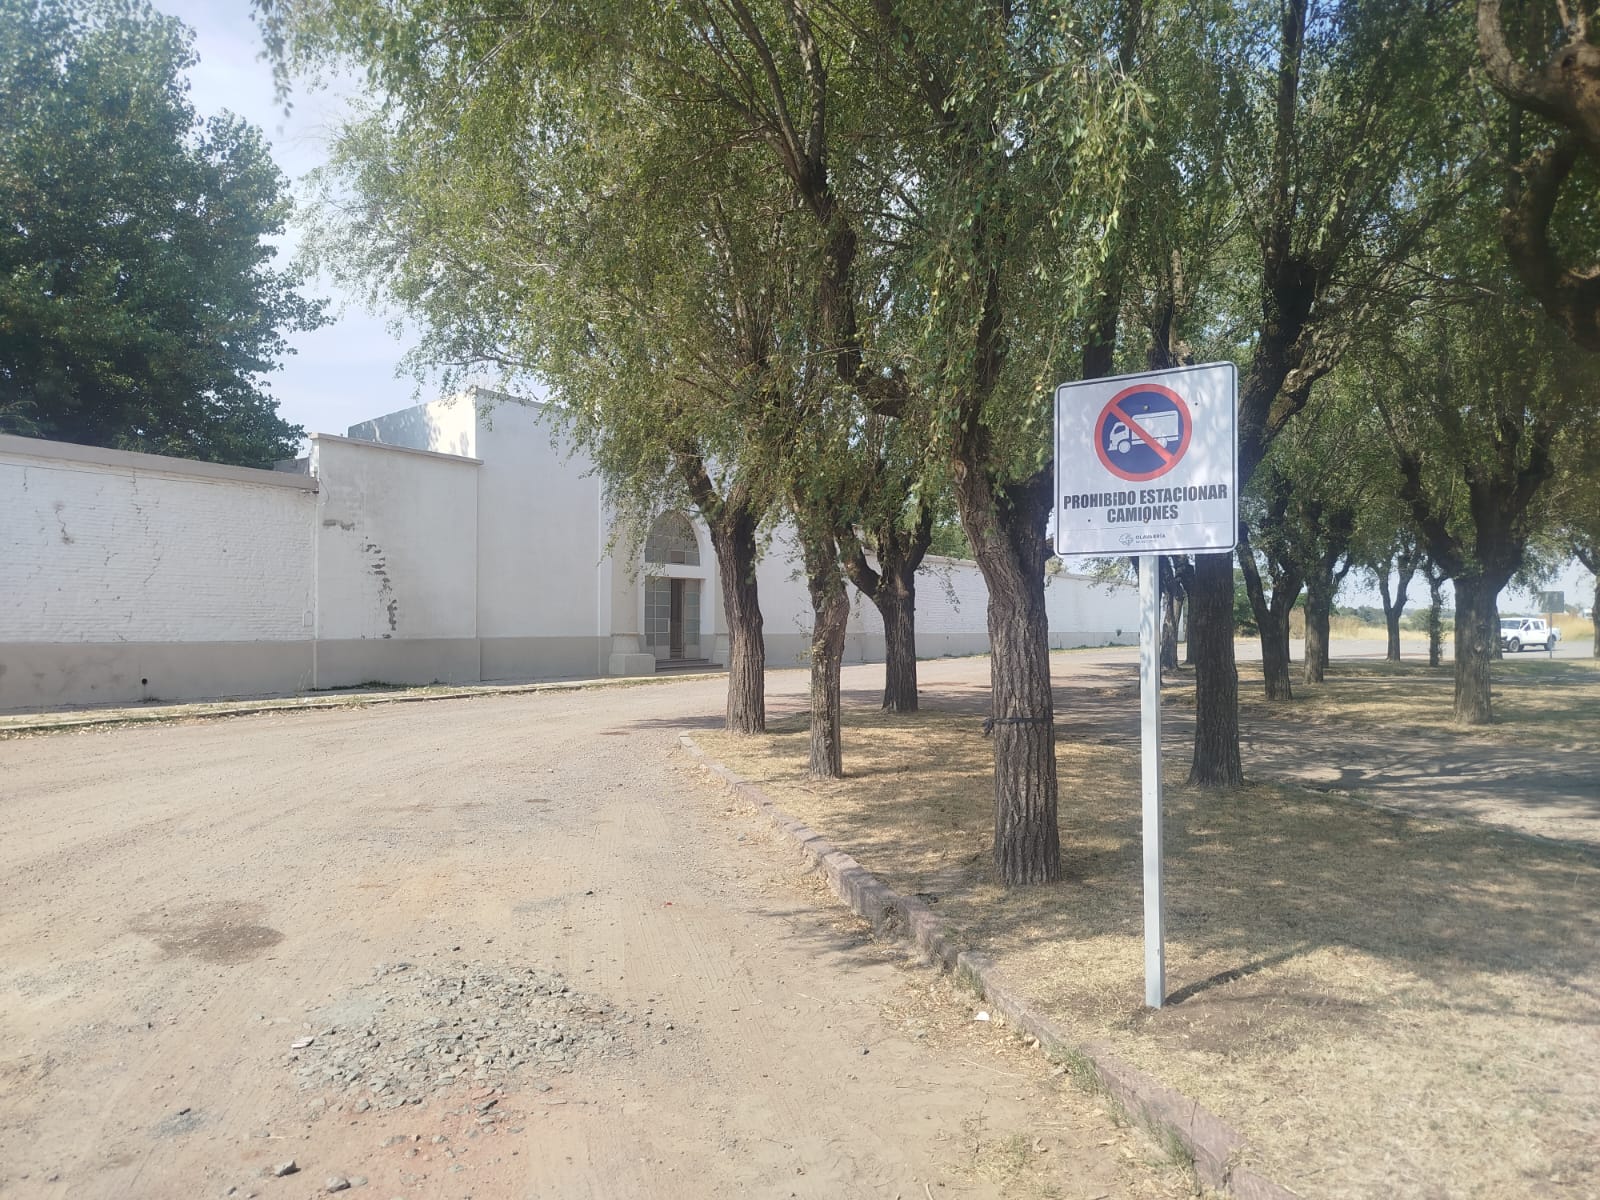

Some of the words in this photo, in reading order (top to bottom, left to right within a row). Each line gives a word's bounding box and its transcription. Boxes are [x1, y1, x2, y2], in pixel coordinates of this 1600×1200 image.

[1063, 490, 1136, 510] PROHIBIDO
[1139, 484, 1228, 505] ESTACIONAR
[1107, 504, 1179, 523] CAMIONES
